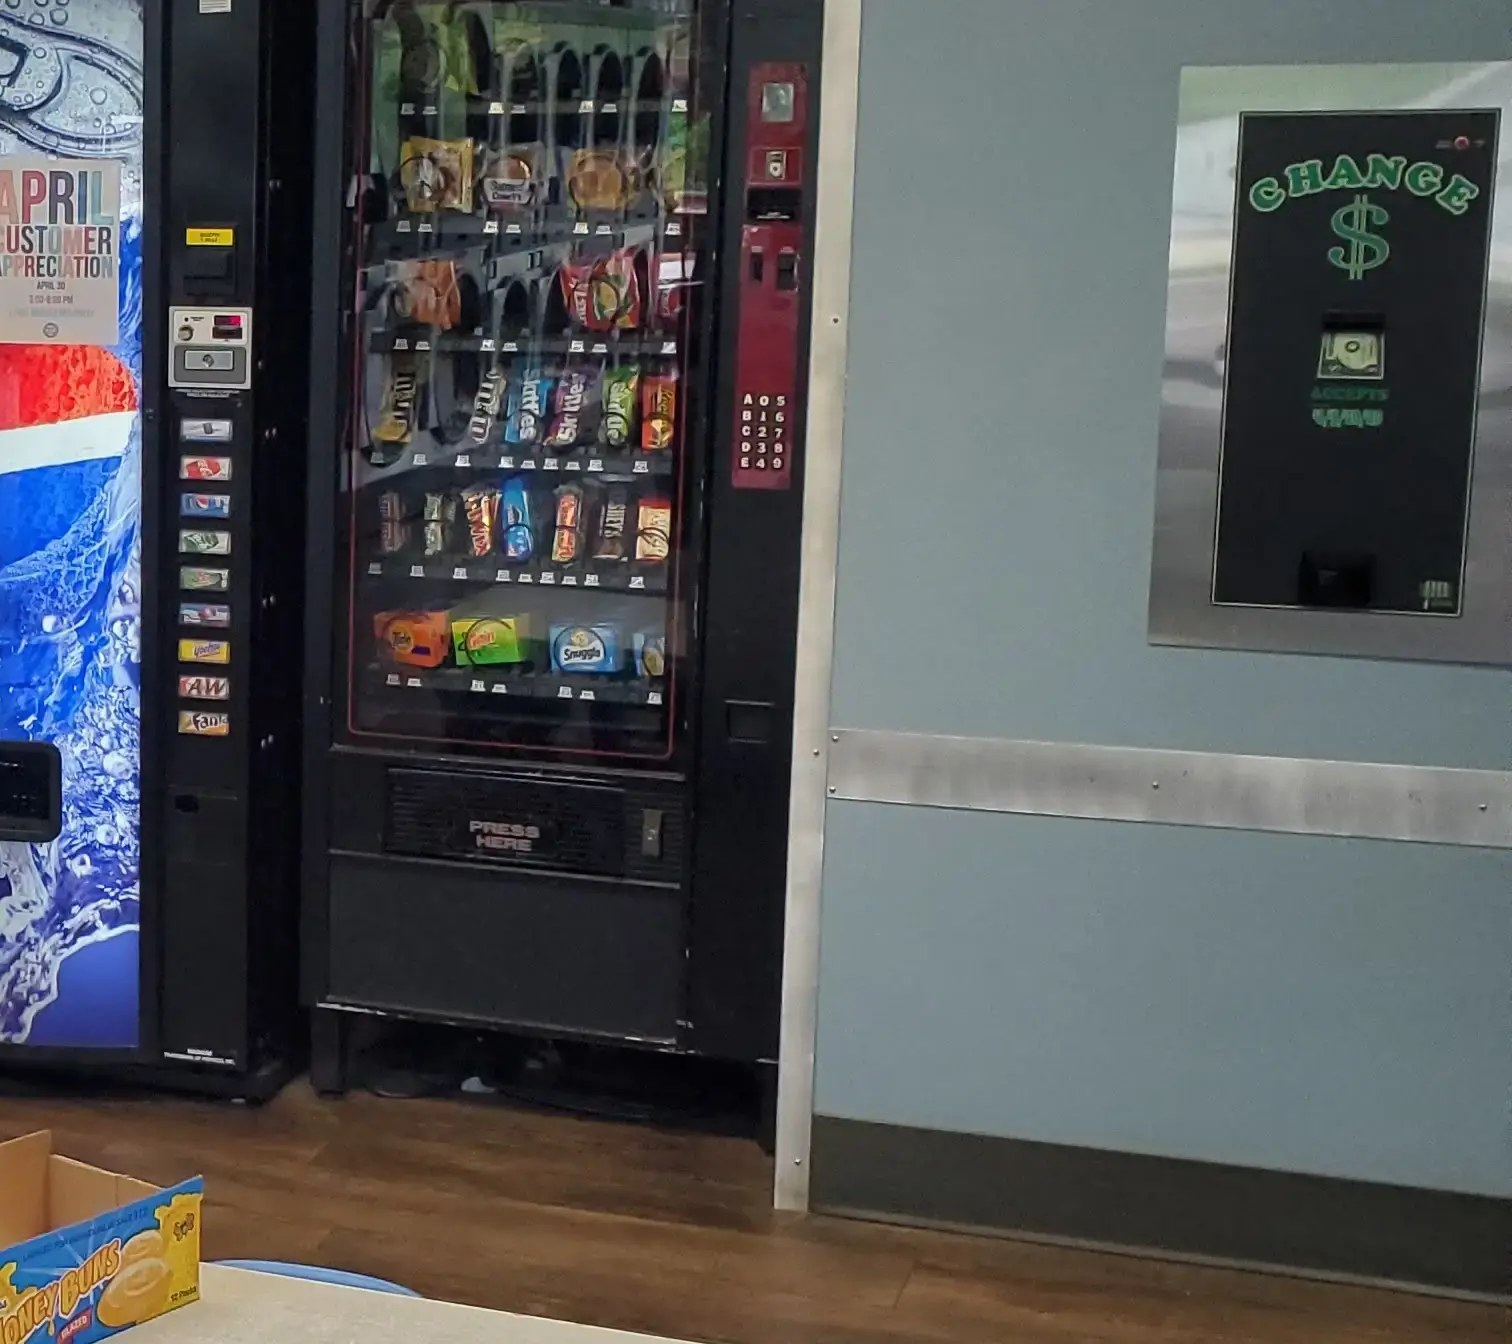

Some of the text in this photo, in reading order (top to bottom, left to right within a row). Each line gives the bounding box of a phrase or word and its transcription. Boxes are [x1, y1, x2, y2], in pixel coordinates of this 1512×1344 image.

[1249, 154, 1480, 217] CHANGE
[36, 281, 55, 290] APRIL
[743, 393, 753, 405] A
[776, 395, 786, 406] 5
[742, 410, 785, 423] B 1 6
[741, 425, 783, 439] C 2 7
[741, 441, 783, 453] D 3 8
[740, 457, 782, 469] E 4 9
[563, 647, 601, 662] Snuggle
[469, 820, 540, 839] PRESS
[475, 834, 533, 852] HERE
[59, 1240, 120, 1316] BUNS
[61, 1314, 88, 1340] GLAZED
